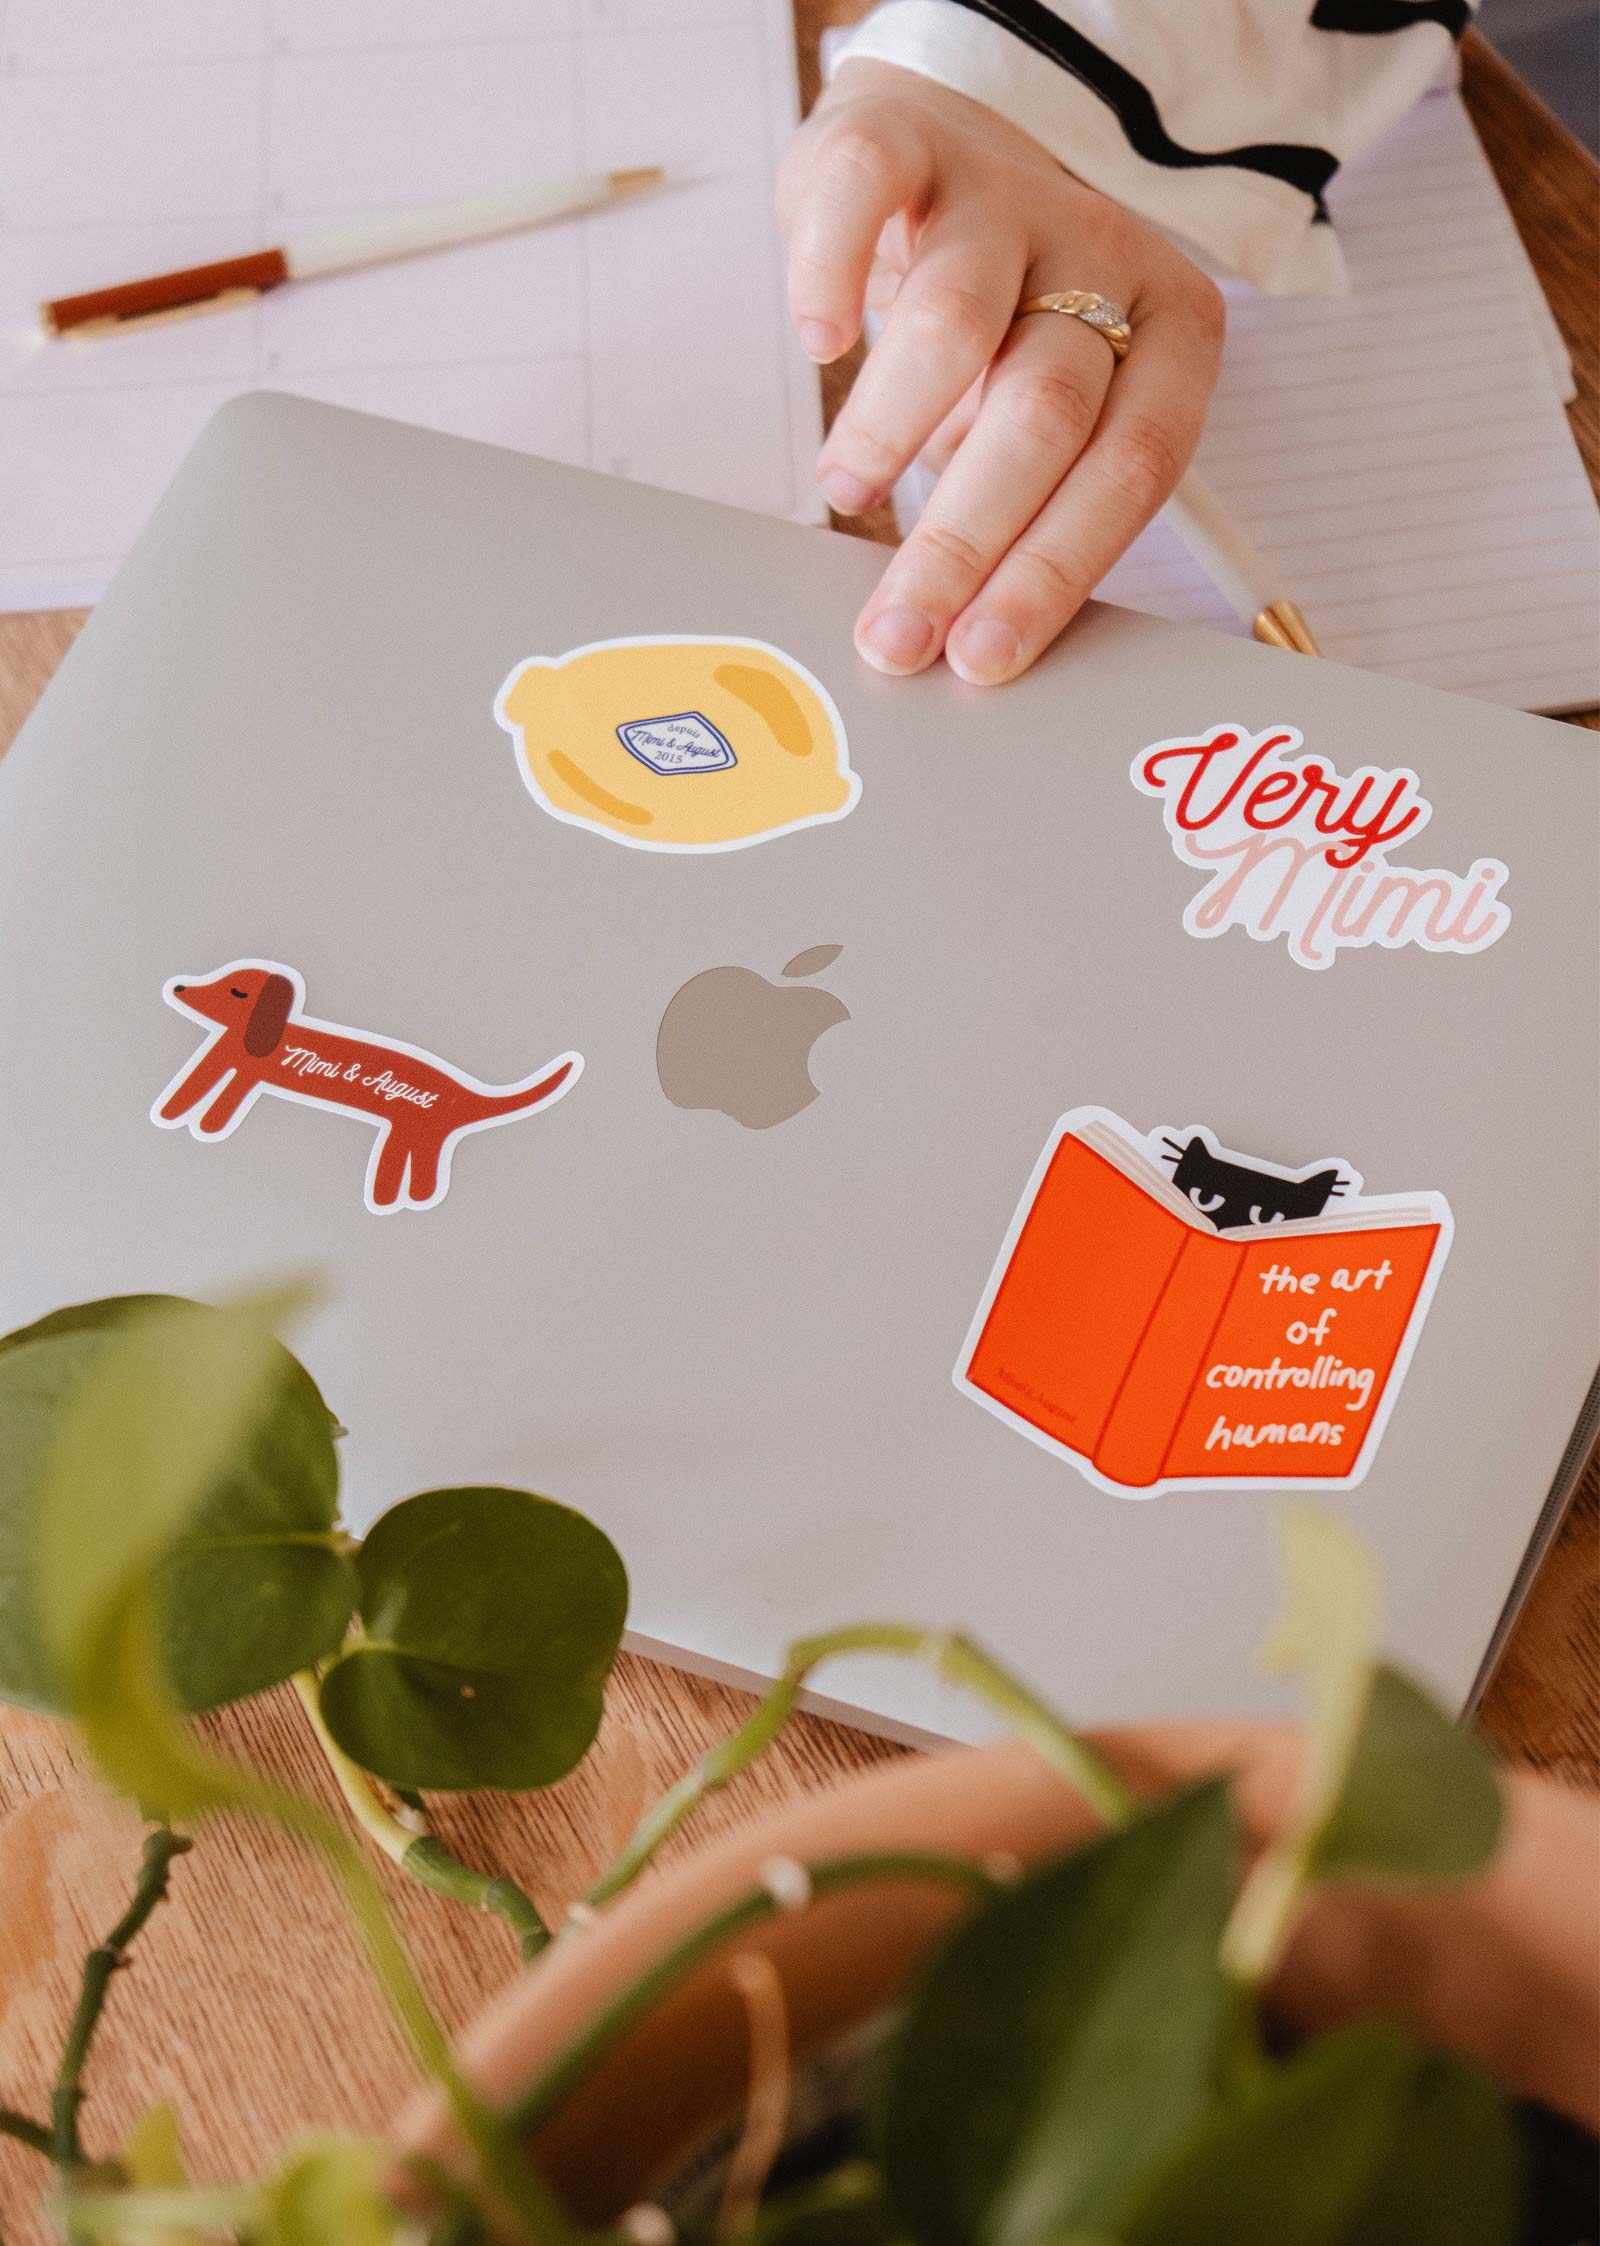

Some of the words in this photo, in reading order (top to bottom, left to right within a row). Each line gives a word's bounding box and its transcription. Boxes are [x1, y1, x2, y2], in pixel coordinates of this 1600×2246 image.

[632, 728, 665, 746] Mimi
[666, 738, 676, 749] &
[676, 741, 722, 758] August
[667, 723, 701, 739] depuis
[654, 750, 684, 764] 2015
[1143, 732, 1421, 869] Very
[1184, 833, 1498, 960] Mimi
[281, 1045, 342, 1077] Mimi
[343, 1063, 361, 1083] &
[362, 1070, 440, 1109] August
[1258, 1264, 1321, 1295] the
[1330, 1259, 1393, 1292] art
[1285, 1307, 1339, 1347] of
[1206, 1355, 1376, 1412] controlling
[1204, 1414, 1346, 1451] humans
